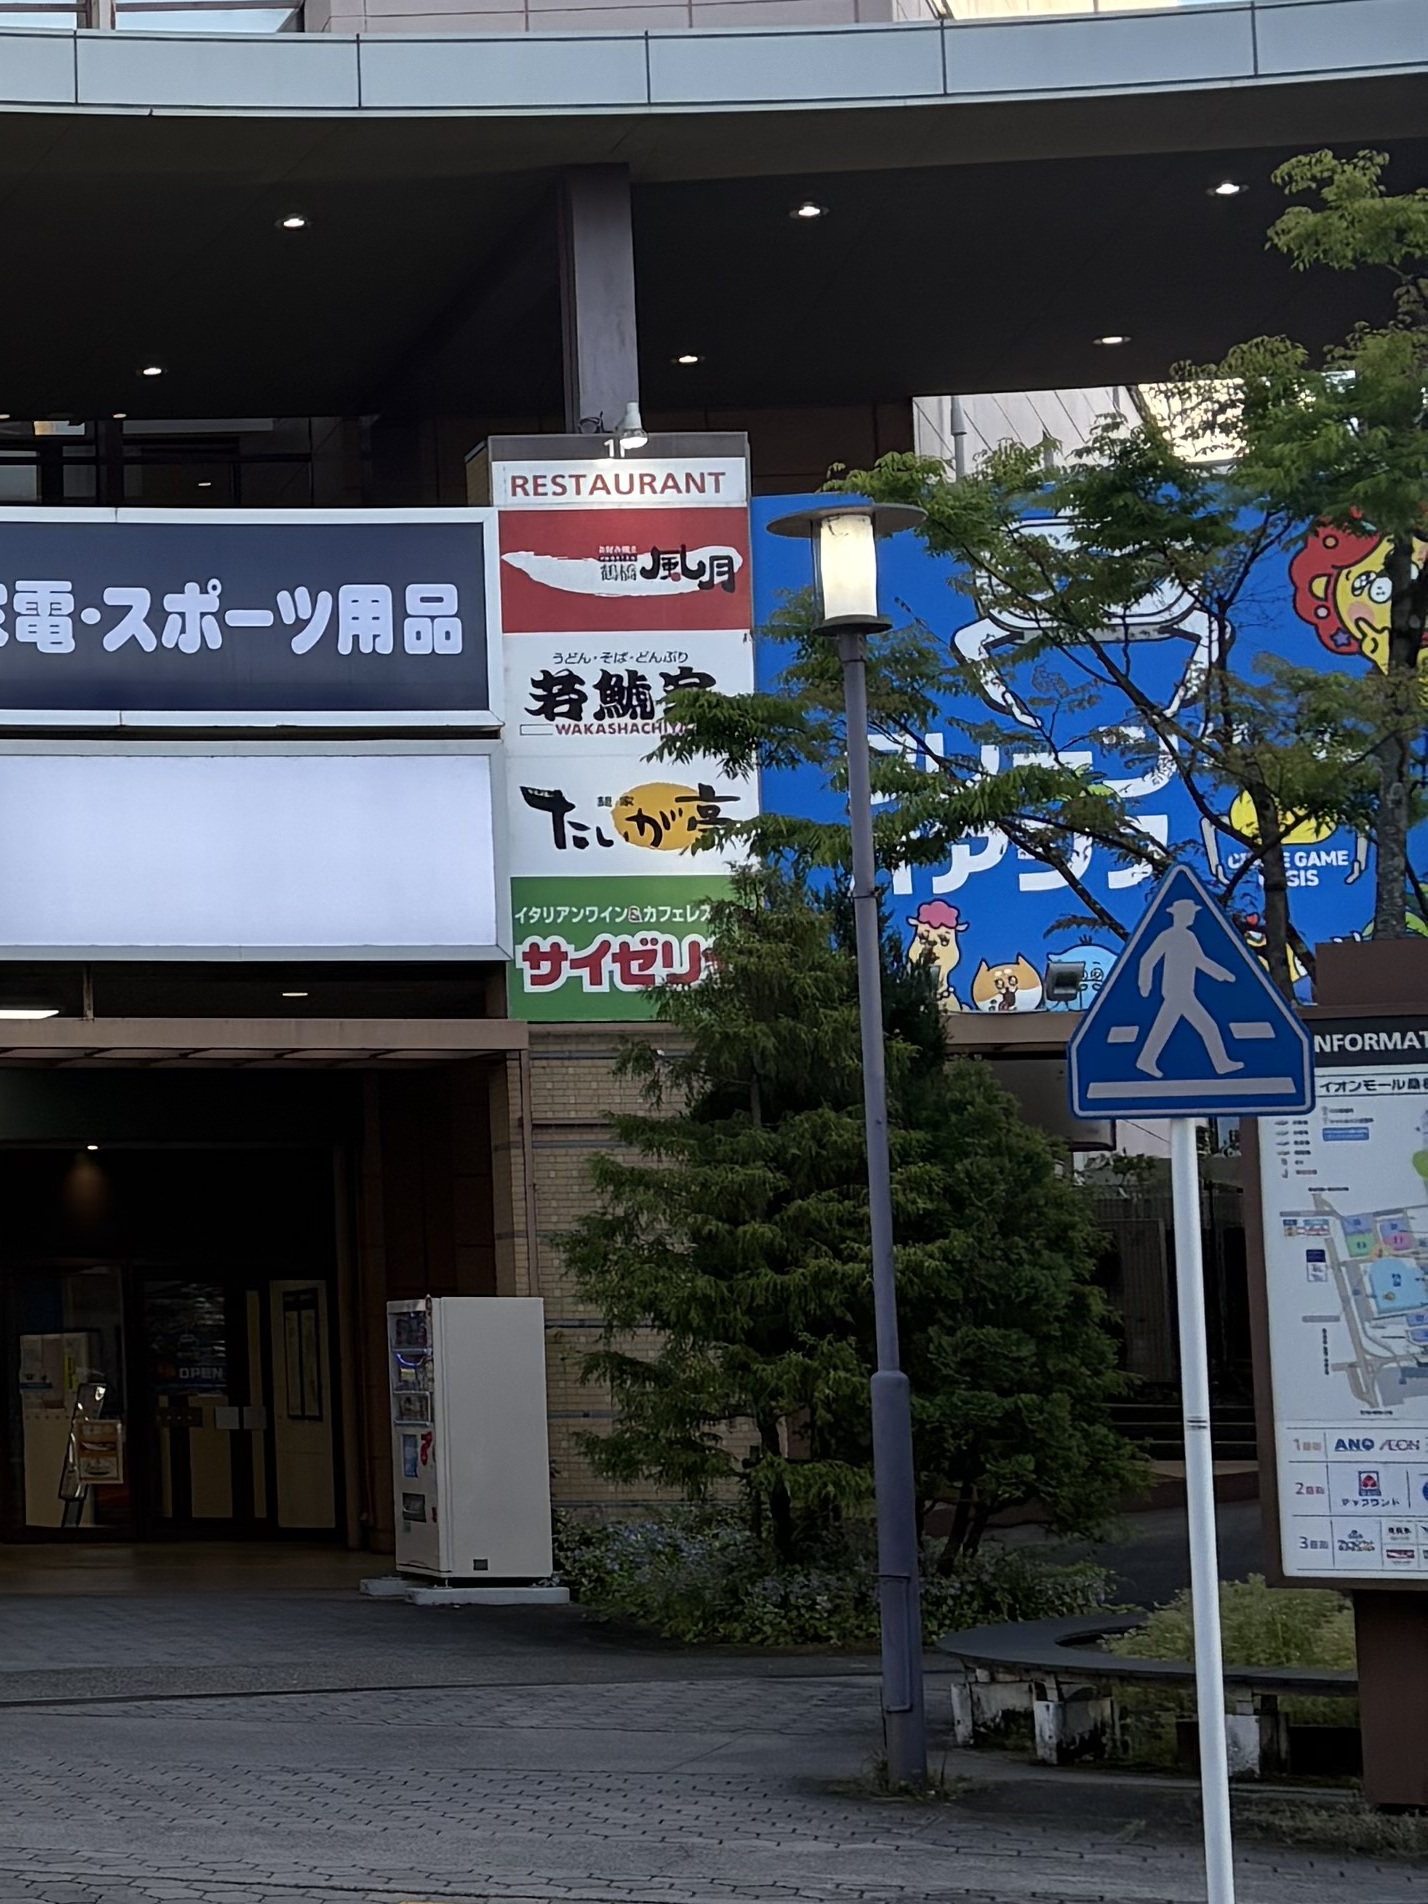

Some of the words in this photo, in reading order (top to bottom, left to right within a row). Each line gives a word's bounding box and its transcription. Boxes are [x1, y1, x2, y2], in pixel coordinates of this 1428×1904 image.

[510, 472, 726, 497] RESTAURANT
[639, 544, 735, 593] 風月
[1294, 850, 1349, 868] GAME
[514, 905, 711, 924] イタリアンワイン&カフェレス
[520, 936, 718, 988] サイゼリ
[1314, 1031, 1428, 1053] NFORMAT
[178, 1367, 224, 1379] OPEN
